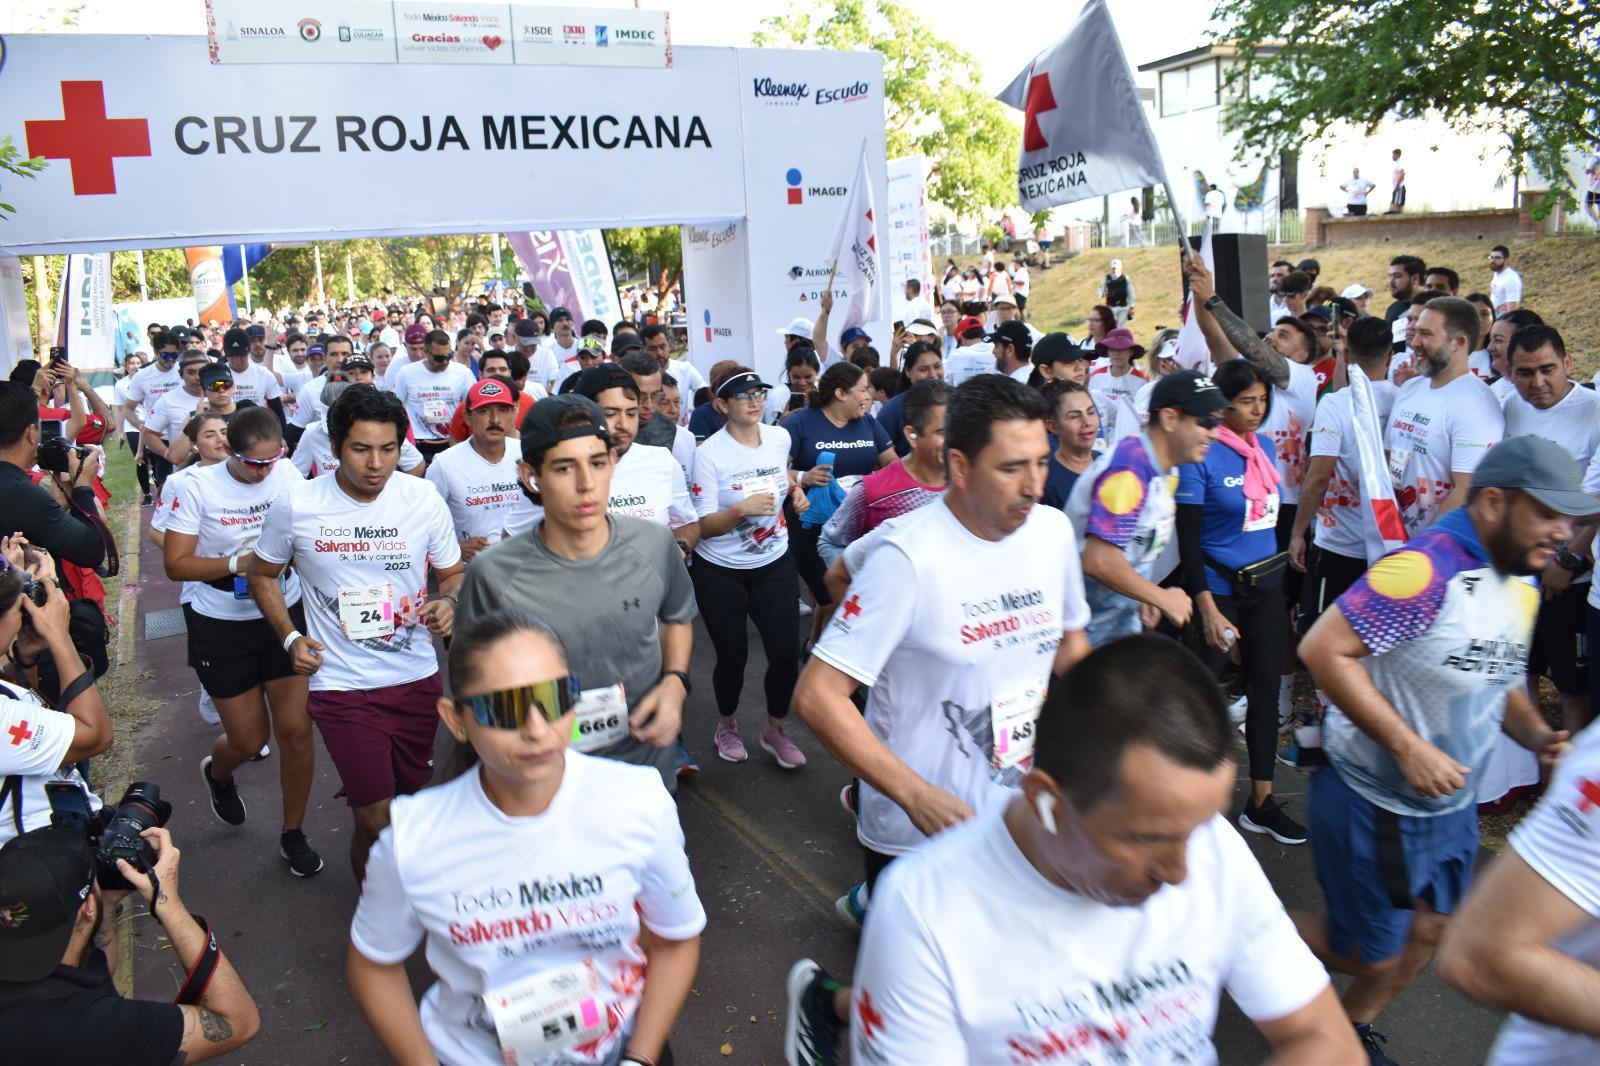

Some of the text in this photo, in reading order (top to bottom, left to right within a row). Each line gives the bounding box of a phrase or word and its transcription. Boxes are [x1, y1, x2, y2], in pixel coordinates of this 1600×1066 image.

[240, 27, 285, 36] SINALOA
[531, 26, 552, 35] ISDE
[615, 29, 655, 40] IMDEC
[412, 33, 460, 43] Gracias
[754, 78, 869, 105] Kleenex Escudo
[174, 114, 713, 155] CRUZ ROJA MEXICANA
[1050, 151, 1087, 176] ROJA
[811, 289, 848, 300] DETA
[713, 327, 732, 337] IMAGEN
[815, 439, 875, 450] GoldenStar
[466, 481, 520, 495] Todo México
[465, 492, 503, 507] Salvando
[220, 512, 262, 527] Salvando
[319, 525, 398, 539] Todo México
[314, 539, 407, 553] Salvando Vidas
[384, 561, 411, 571] 2023
[1000, 588, 1044, 613] México
[360, 609, 382, 624] 24
[960, 614, 1022, 645] Salvando
[450, 870, 604, 916] Todo México
[448, 899, 621, 947] Salvando Vidas
[1091, 957, 1195, 1018] México
